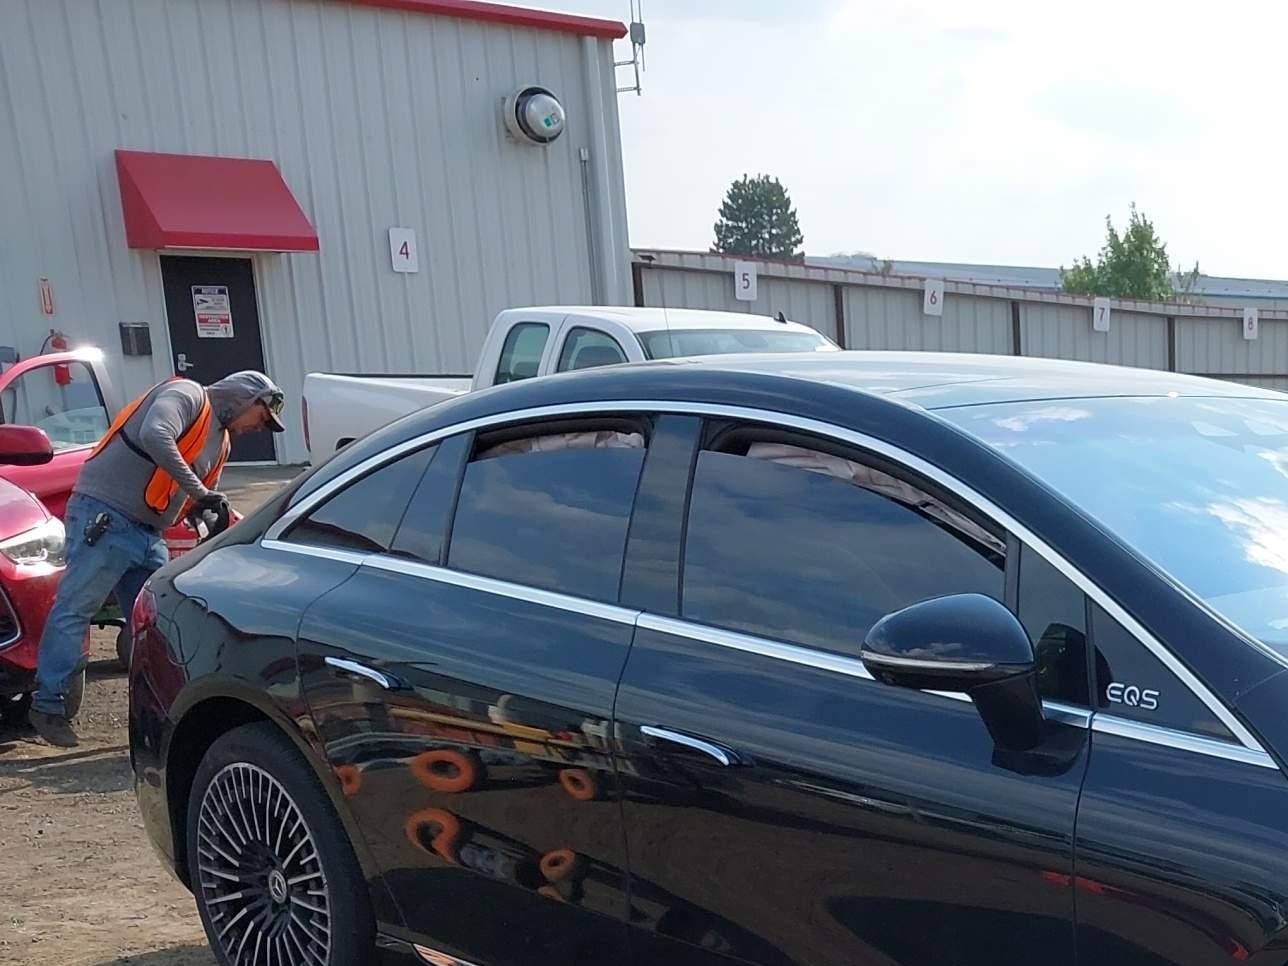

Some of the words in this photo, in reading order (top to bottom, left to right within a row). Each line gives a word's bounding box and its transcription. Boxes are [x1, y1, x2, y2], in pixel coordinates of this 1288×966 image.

[399, 240, 409, 260] 4
[742, 272, 750, 290] 5
[930, 290, 937, 305] 6
[1098, 306, 1105, 321] 7
[1106, 682, 1160, 710] EQS
